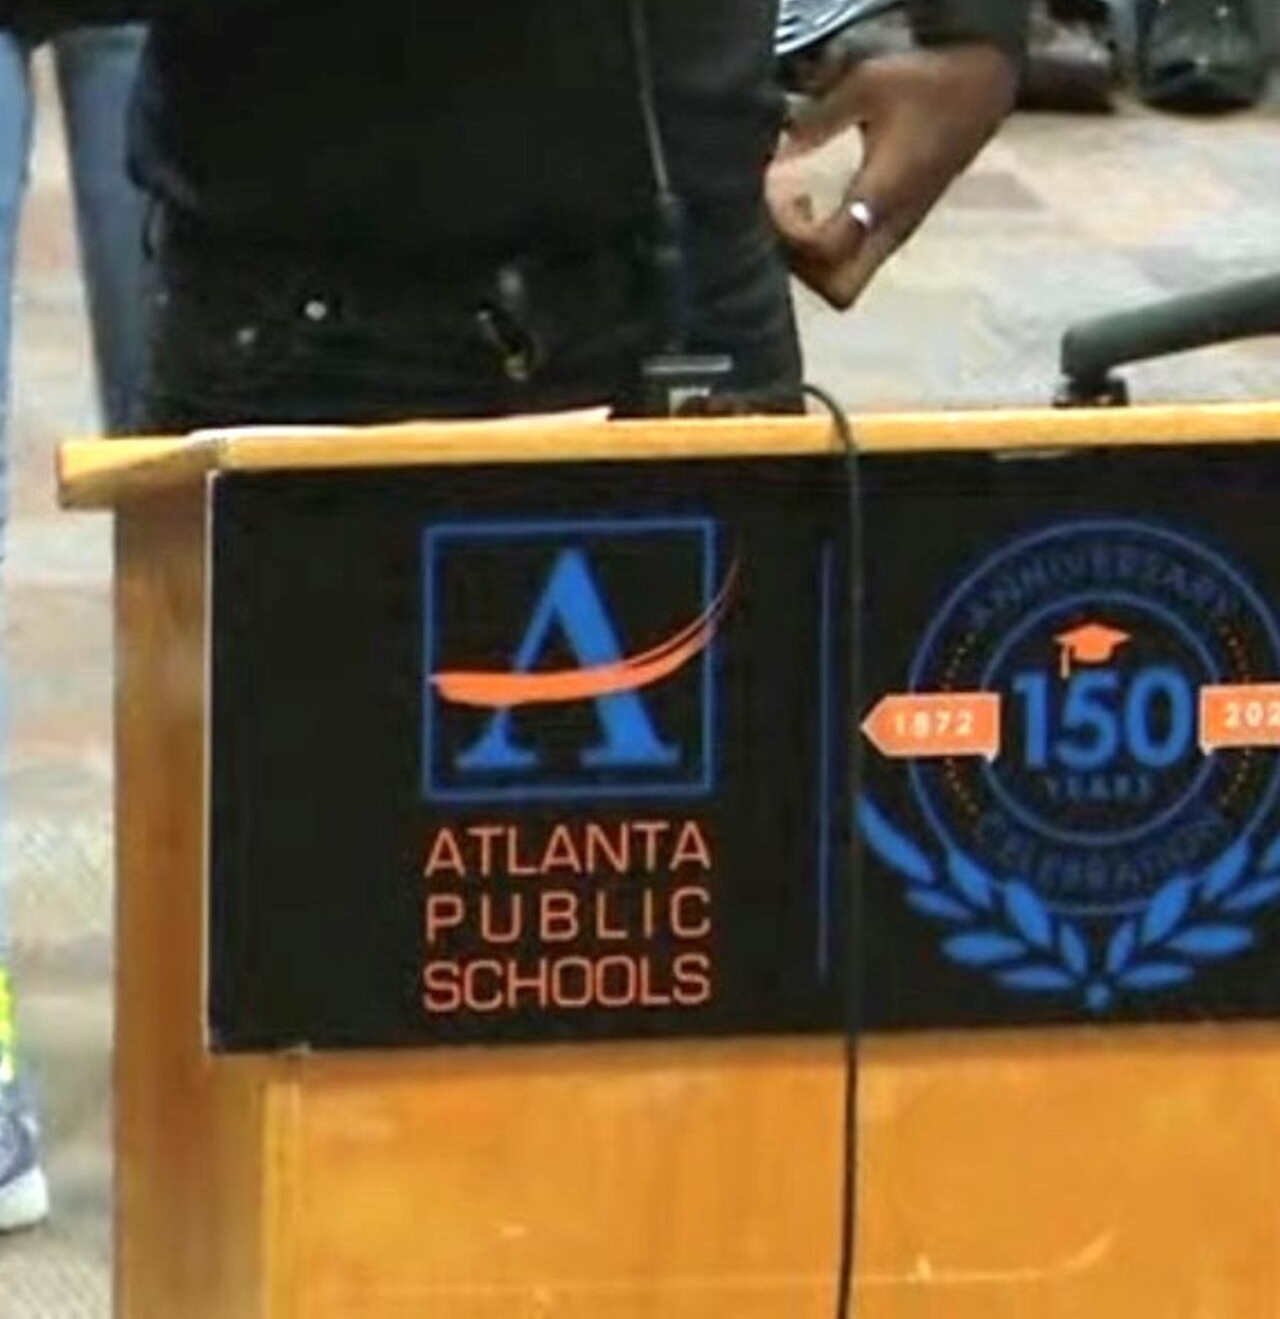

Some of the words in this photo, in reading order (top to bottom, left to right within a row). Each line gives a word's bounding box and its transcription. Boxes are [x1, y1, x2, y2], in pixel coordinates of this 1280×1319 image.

[893, 709, 975, 740] 1872
[1012, 665, 1194, 769] 150
[1046, 772, 1155, 801] YEARS
[424, 820, 713, 877] ATLANTA
[424, 885, 713, 944] PUBLIC
[422, 953, 713, 1012] SCHOOLS
